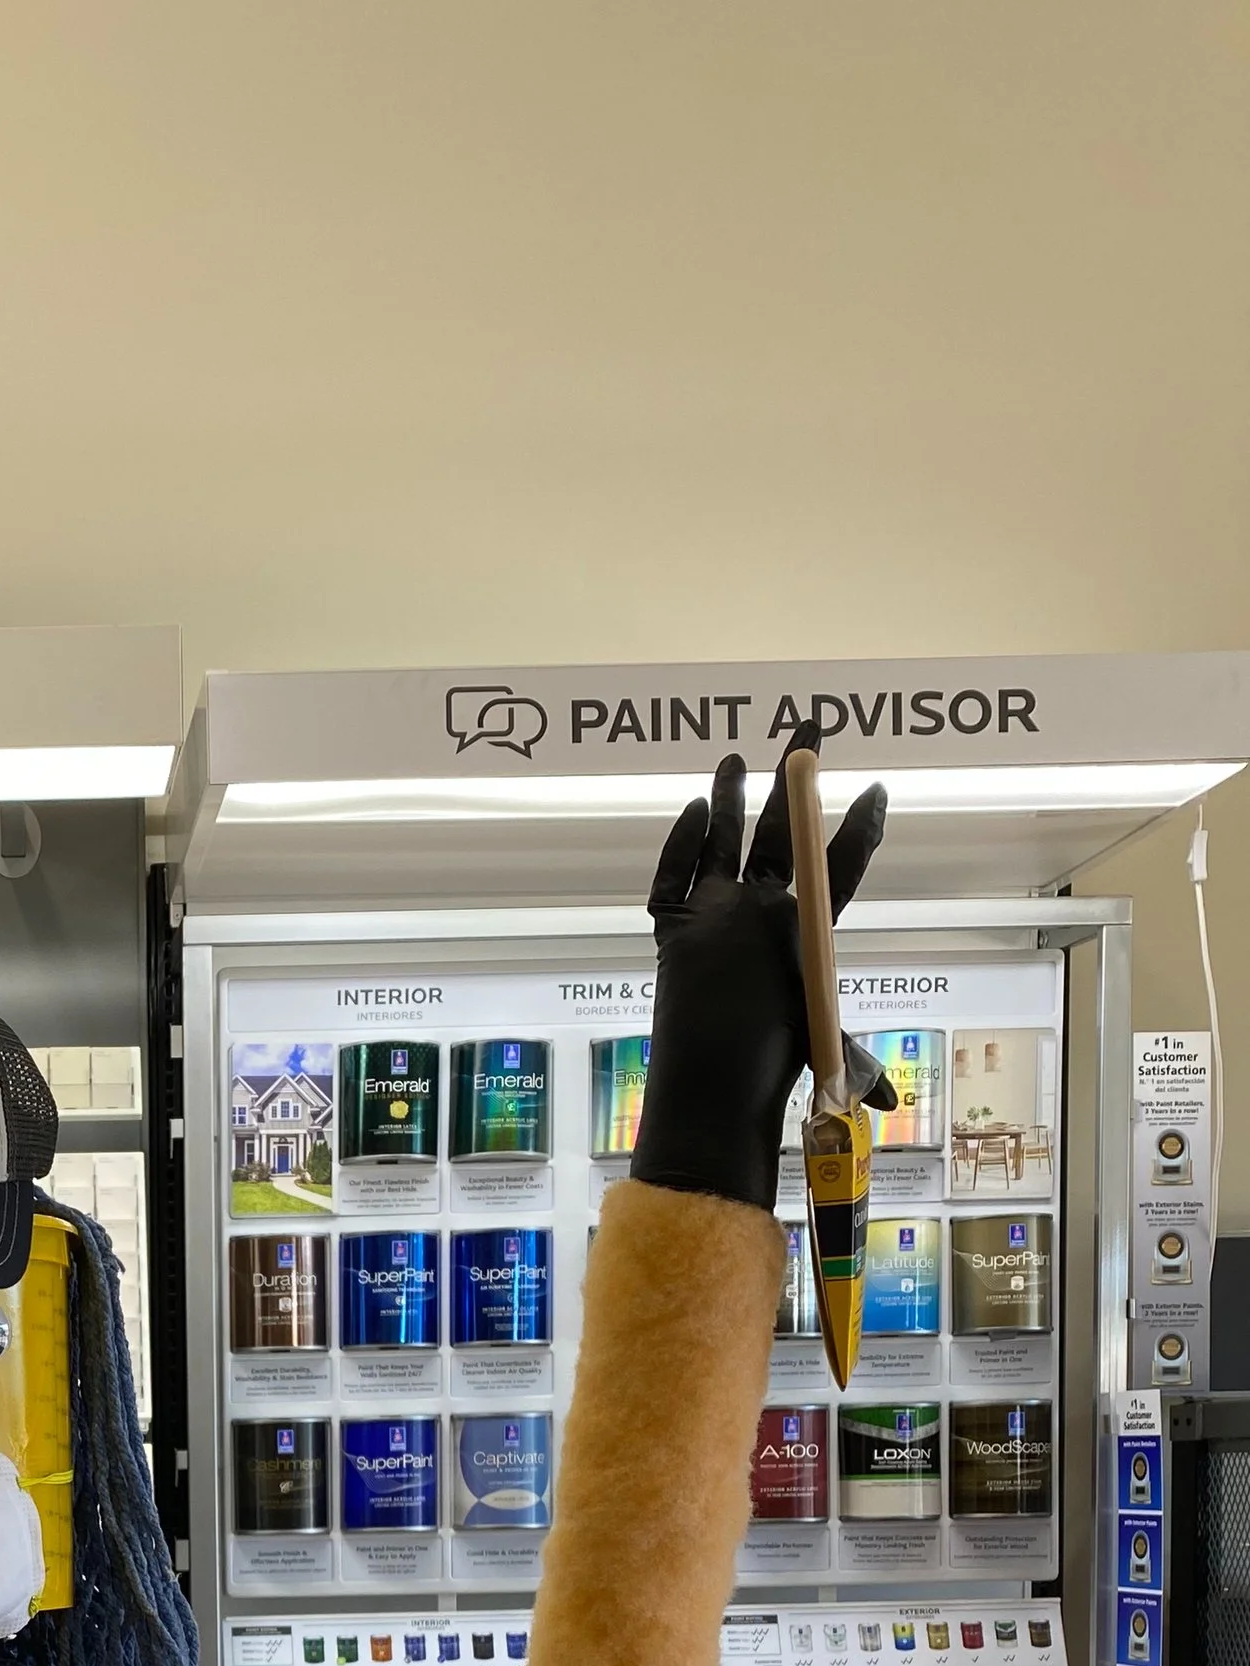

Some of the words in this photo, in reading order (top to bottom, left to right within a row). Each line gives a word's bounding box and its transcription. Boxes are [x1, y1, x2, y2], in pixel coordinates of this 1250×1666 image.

[570, 695, 753, 745] PAINT
[767, 688, 1040, 741] ADVISOR
[558, 983, 613, 1000] TRIM
[838, 976, 949, 995] EXTERIOR
[336, 986, 444, 1007] INTERIOR
[858, 1000, 928, 1010] EXTERIORES
[356, 1010, 424, 1021] INTERIORES
[575, 1005, 620, 1016] BORDES
[1153, 1036, 1170, 1050] #1
[1173, 1038, 1184, 1049] in
[1142, 1052, 1199, 1063] Customer
[1138, 1064, 1207, 1077] Satisfaction
[365, 1076, 431, 1094] Emerald
[474, 1072, 544, 1089] Emerald
[871, 1254, 935, 1271] Latitude
[252, 1271, 318, 1288] Duration
[357, 1268, 435, 1287] SuperPaint
[469, 1264, 548, 1283] SuperPaint
[472, 1450, 546, 1468] Captivate
[759, 1443, 819, 1460] A-100
[874, 1447, 932, 1461] LOXON
[356, 1453, 434, 1472] SuperPaint
[899, 1607, 941, 1616] EXTERIOR
[411, 1618, 451, 1627] INTERIOR
